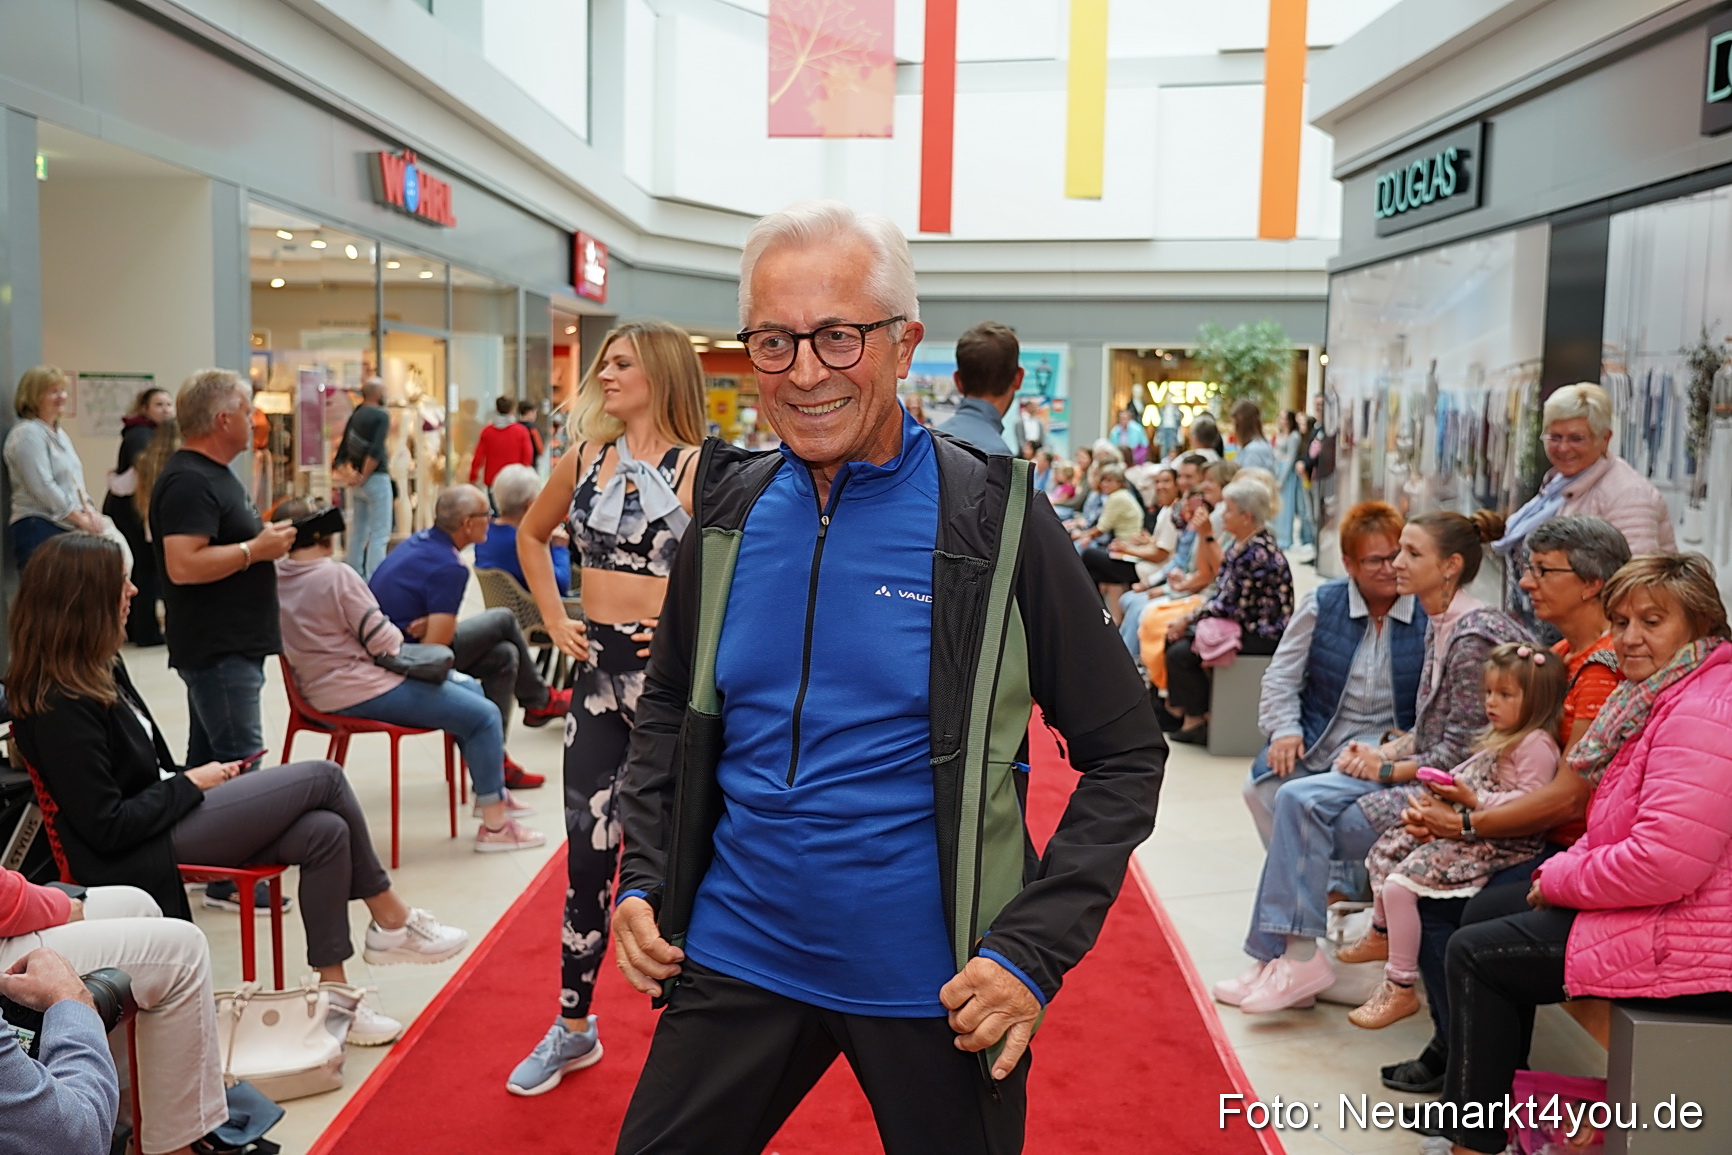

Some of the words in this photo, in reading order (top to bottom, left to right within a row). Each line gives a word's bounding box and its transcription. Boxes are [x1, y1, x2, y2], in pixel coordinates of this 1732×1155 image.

[1375, 146, 1458, 219] DOUGLAS
[898, 589, 933, 603] VAUD
[10, 819, 39, 865] STYLUS
